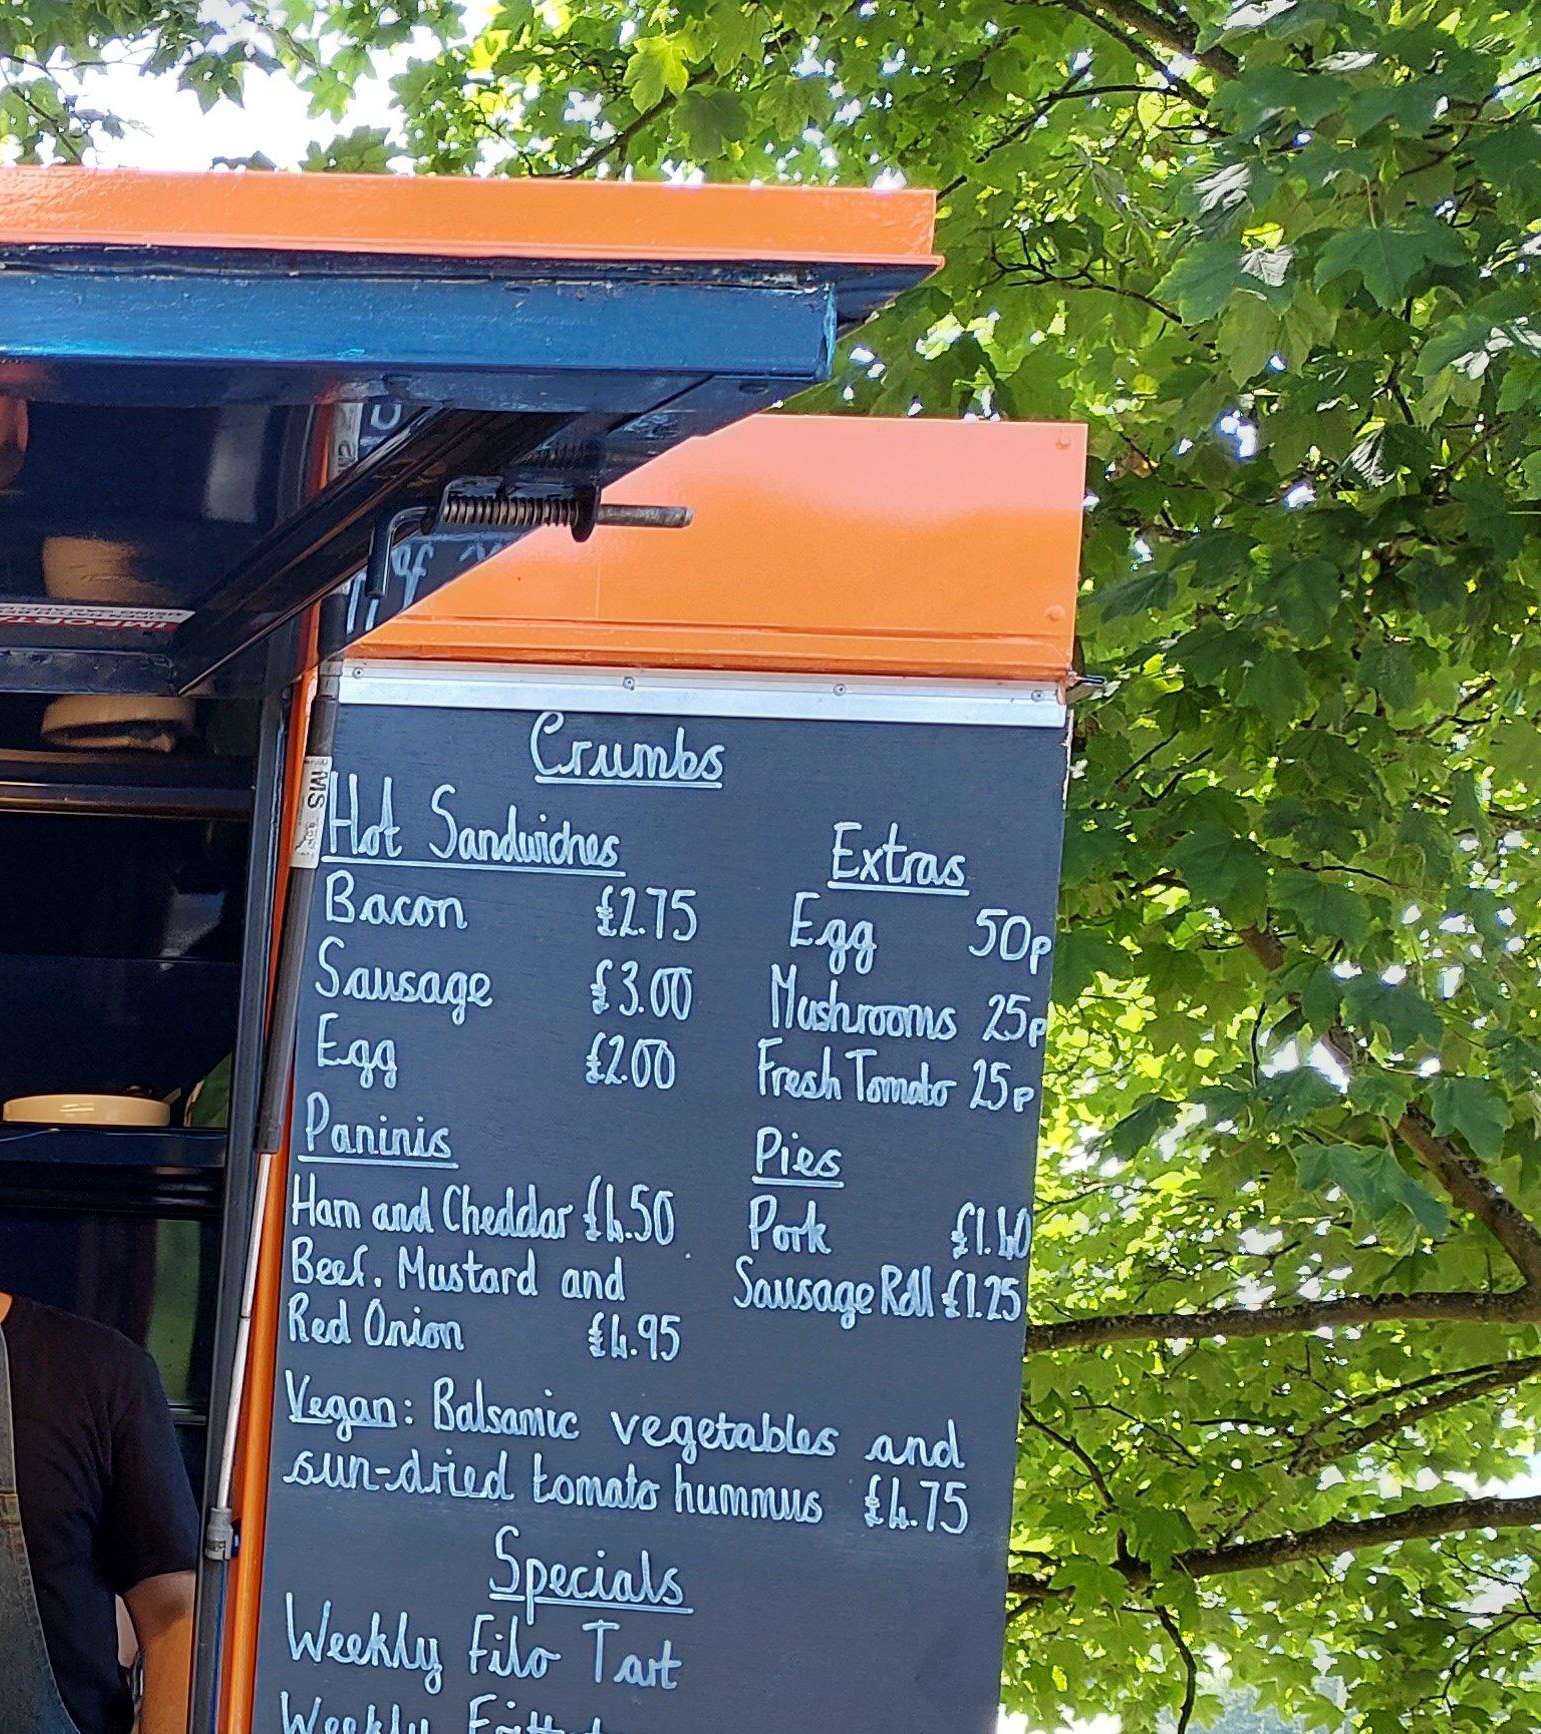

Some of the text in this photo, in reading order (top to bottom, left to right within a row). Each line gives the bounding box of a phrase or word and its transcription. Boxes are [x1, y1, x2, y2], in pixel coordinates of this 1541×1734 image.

[531, 712, 724, 780] Crumbs
[330, 771, 619, 867] Hot Sandwiches
[833, 822, 965, 886] Extras
[327, 870, 696, 940] Bacon £2.75
[316, 936, 692, 1025] Sausage £3.00
[306, 1092, 451, 1158] Paninis
[757, 1127, 841, 1177] Pies
[292, 1173, 674, 1245] Ham and Cheddar £4.50
[749, 1195, 831, 1254] Pork
[289, 1292, 680, 1360] Red Onion £4.95
[434, 1377, 965, 1468] Balsamic vegetables and
[283, 1449, 967, 1533] sun-dried tomato hummus £4.75
[489, 1526, 682, 1625] Specials
[286, 1593, 681, 1693] Weekly Filo Tart
